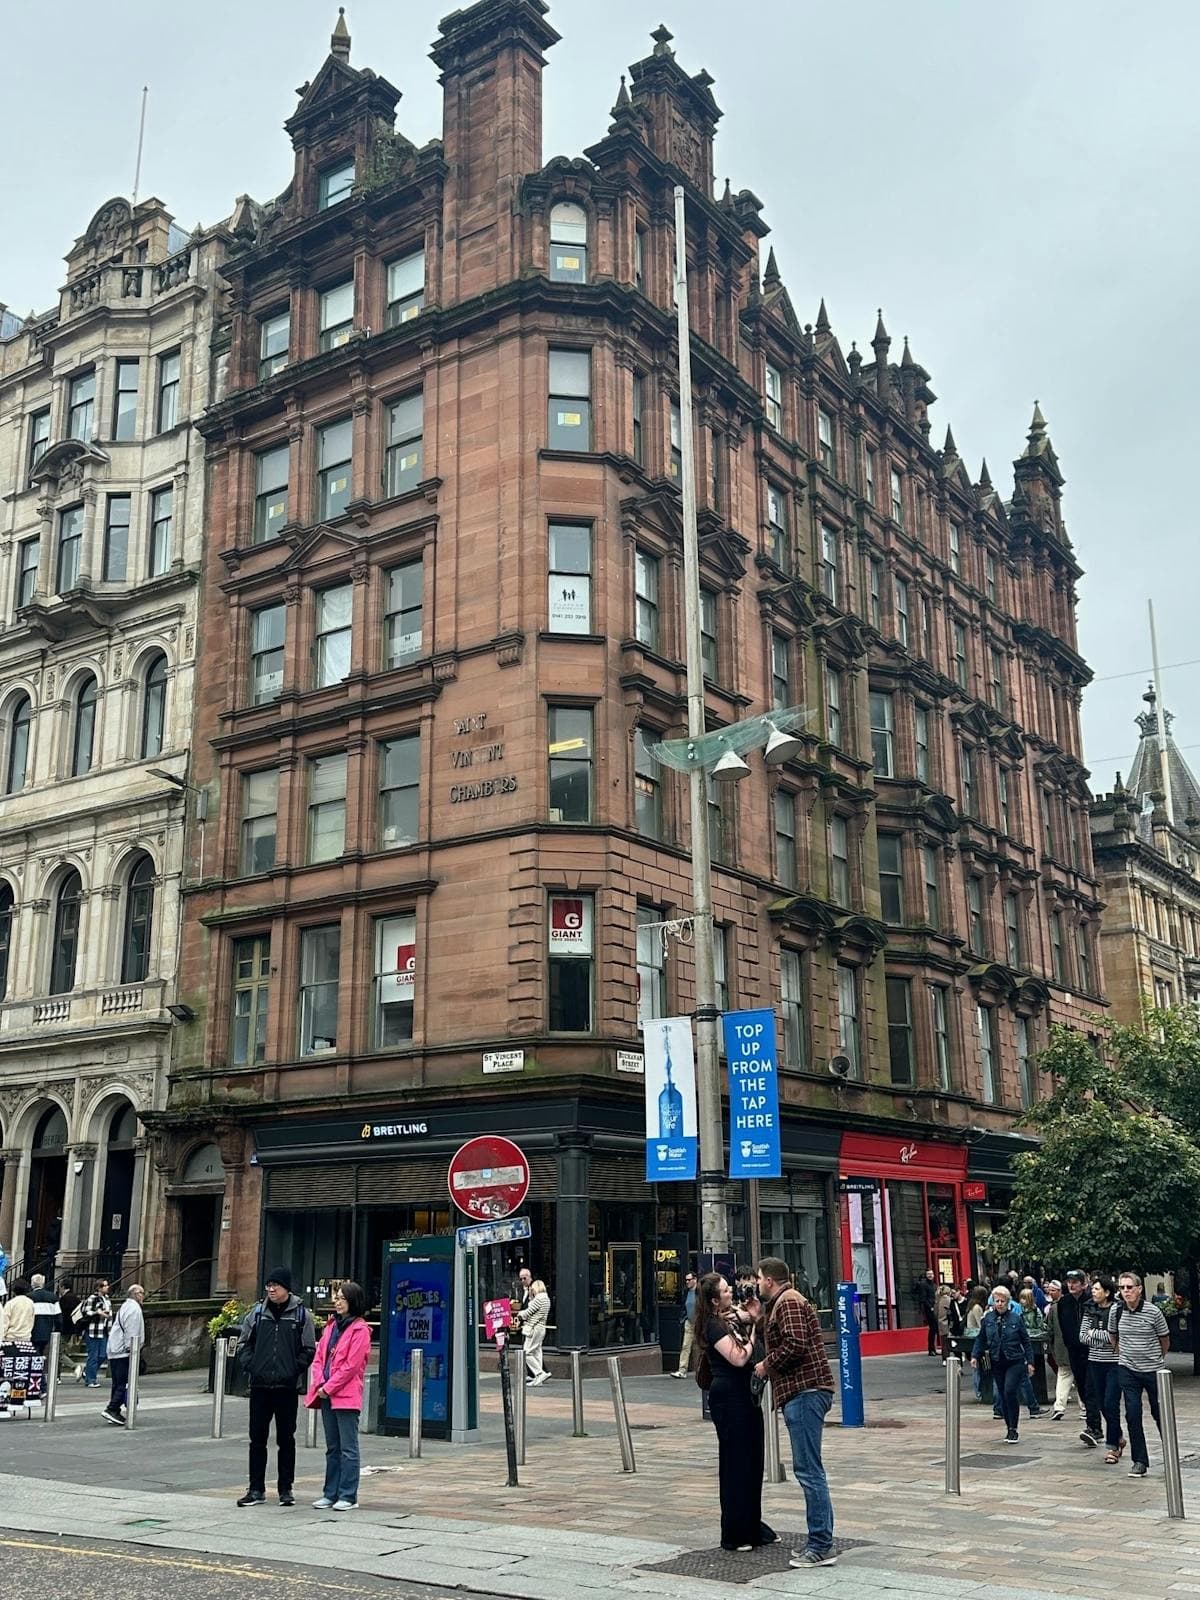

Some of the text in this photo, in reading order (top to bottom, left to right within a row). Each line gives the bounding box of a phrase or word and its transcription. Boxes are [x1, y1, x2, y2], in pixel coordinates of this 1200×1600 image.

[450, 743, 505, 769] VINNT
[552, 930, 582, 938] GIANT
[396, 974, 415, 983] GIAN
[735, 1024, 764, 1039] TOP
[495, 1052, 522, 1060] VINCENT
[741, 1043, 760, 1056] UP
[492, 1060, 514, 1068] PLACE
[732, 1059, 772, 1075] FROM
[740, 1078, 766, 1092] THE
[742, 1096, 766, 1110] TAP
[736, 1114, 773, 1129] HERE
[373, 1122, 428, 1136] BREITLING
[205, 1164, 212, 1174] 41
[838, 1296, 846, 1310] life
[408, 1319, 430, 1331] CORN
[408, 1331, 429, 1340] FLAKES
